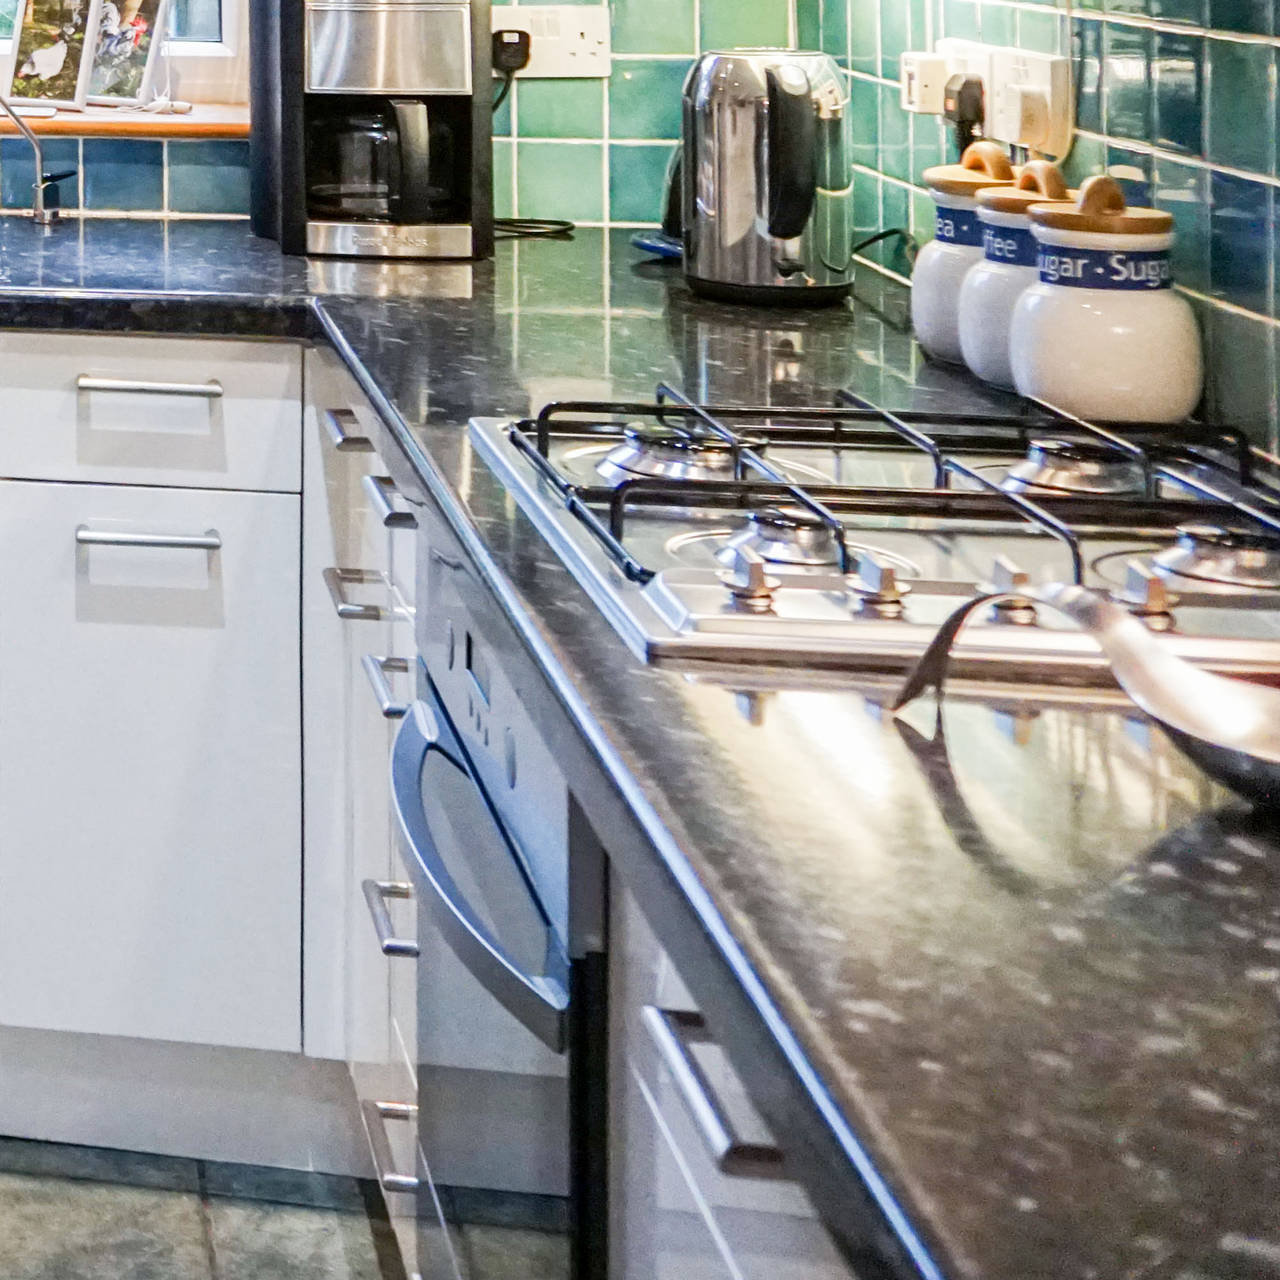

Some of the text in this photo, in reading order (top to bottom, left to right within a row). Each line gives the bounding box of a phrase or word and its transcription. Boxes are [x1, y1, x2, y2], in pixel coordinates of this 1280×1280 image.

[936, 218, 954, 238] ea
[984, 229, 1017, 258] ffee
[1039, 254, 1169, 287] ugar Suga
